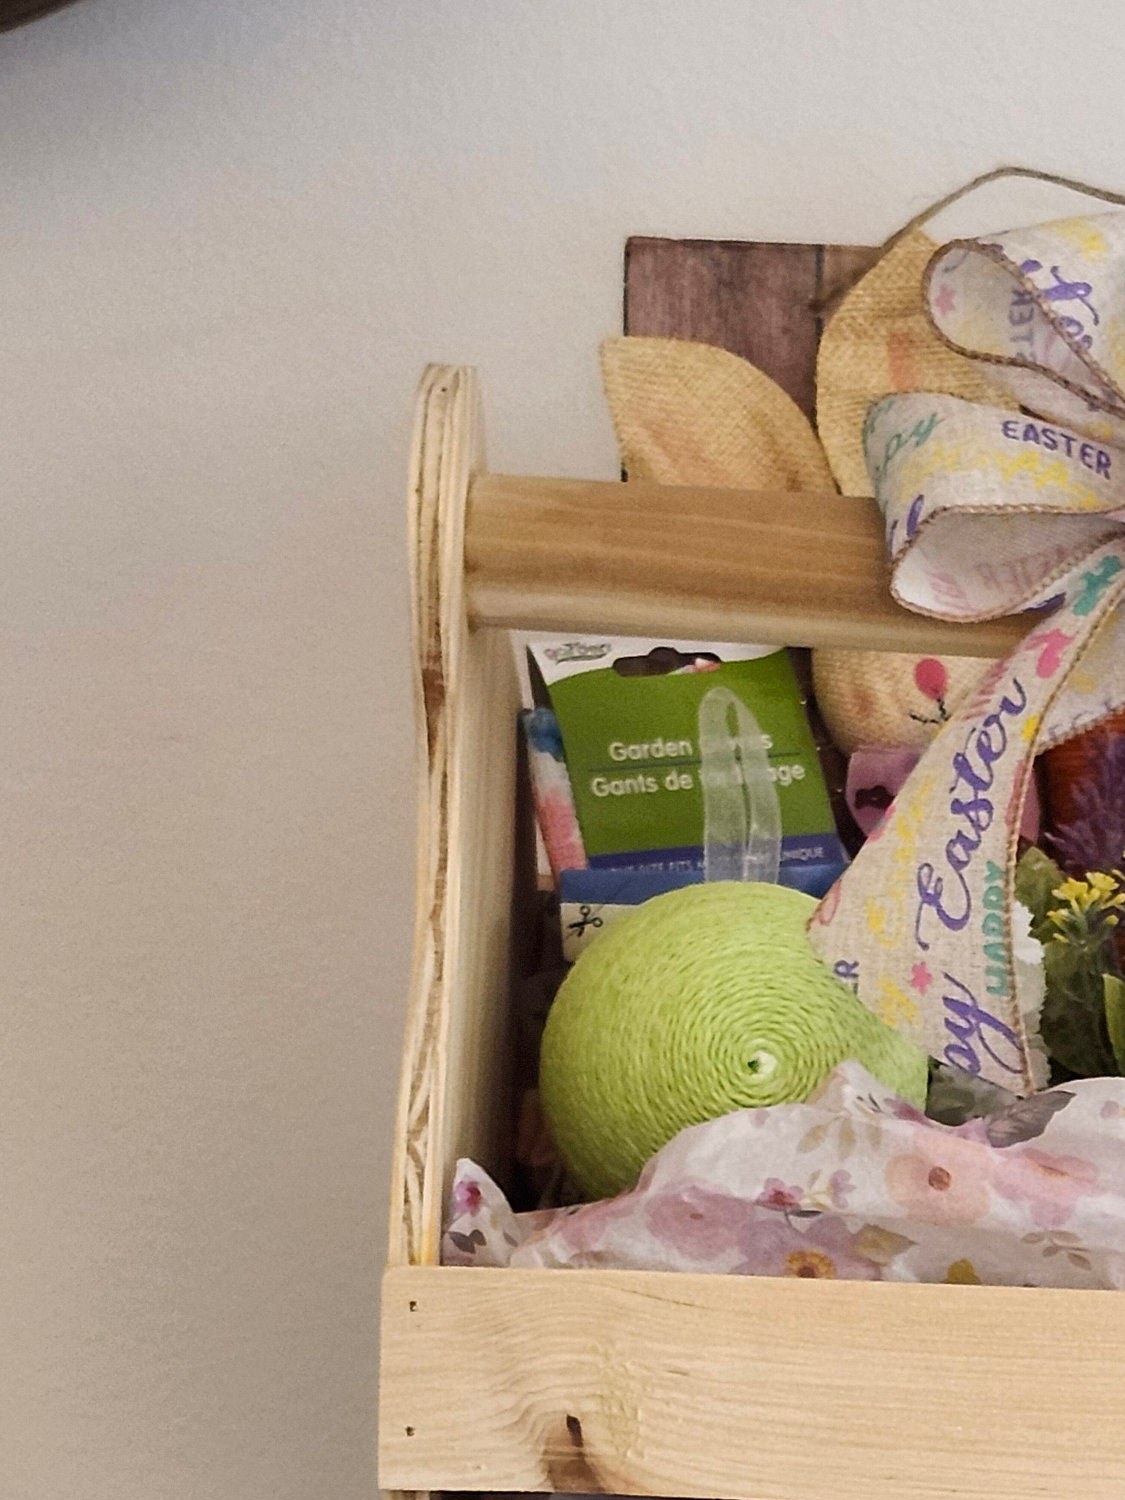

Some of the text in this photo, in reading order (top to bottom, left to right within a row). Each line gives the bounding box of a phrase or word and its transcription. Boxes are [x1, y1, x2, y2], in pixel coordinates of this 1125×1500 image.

[1001, 420, 1113, 481] EASTER
[609, 738, 693, 762] Garden
[591, 774, 659, 798] Gants
[665, 770, 694, 791] de
[916, 677, 1028, 951] Easter
